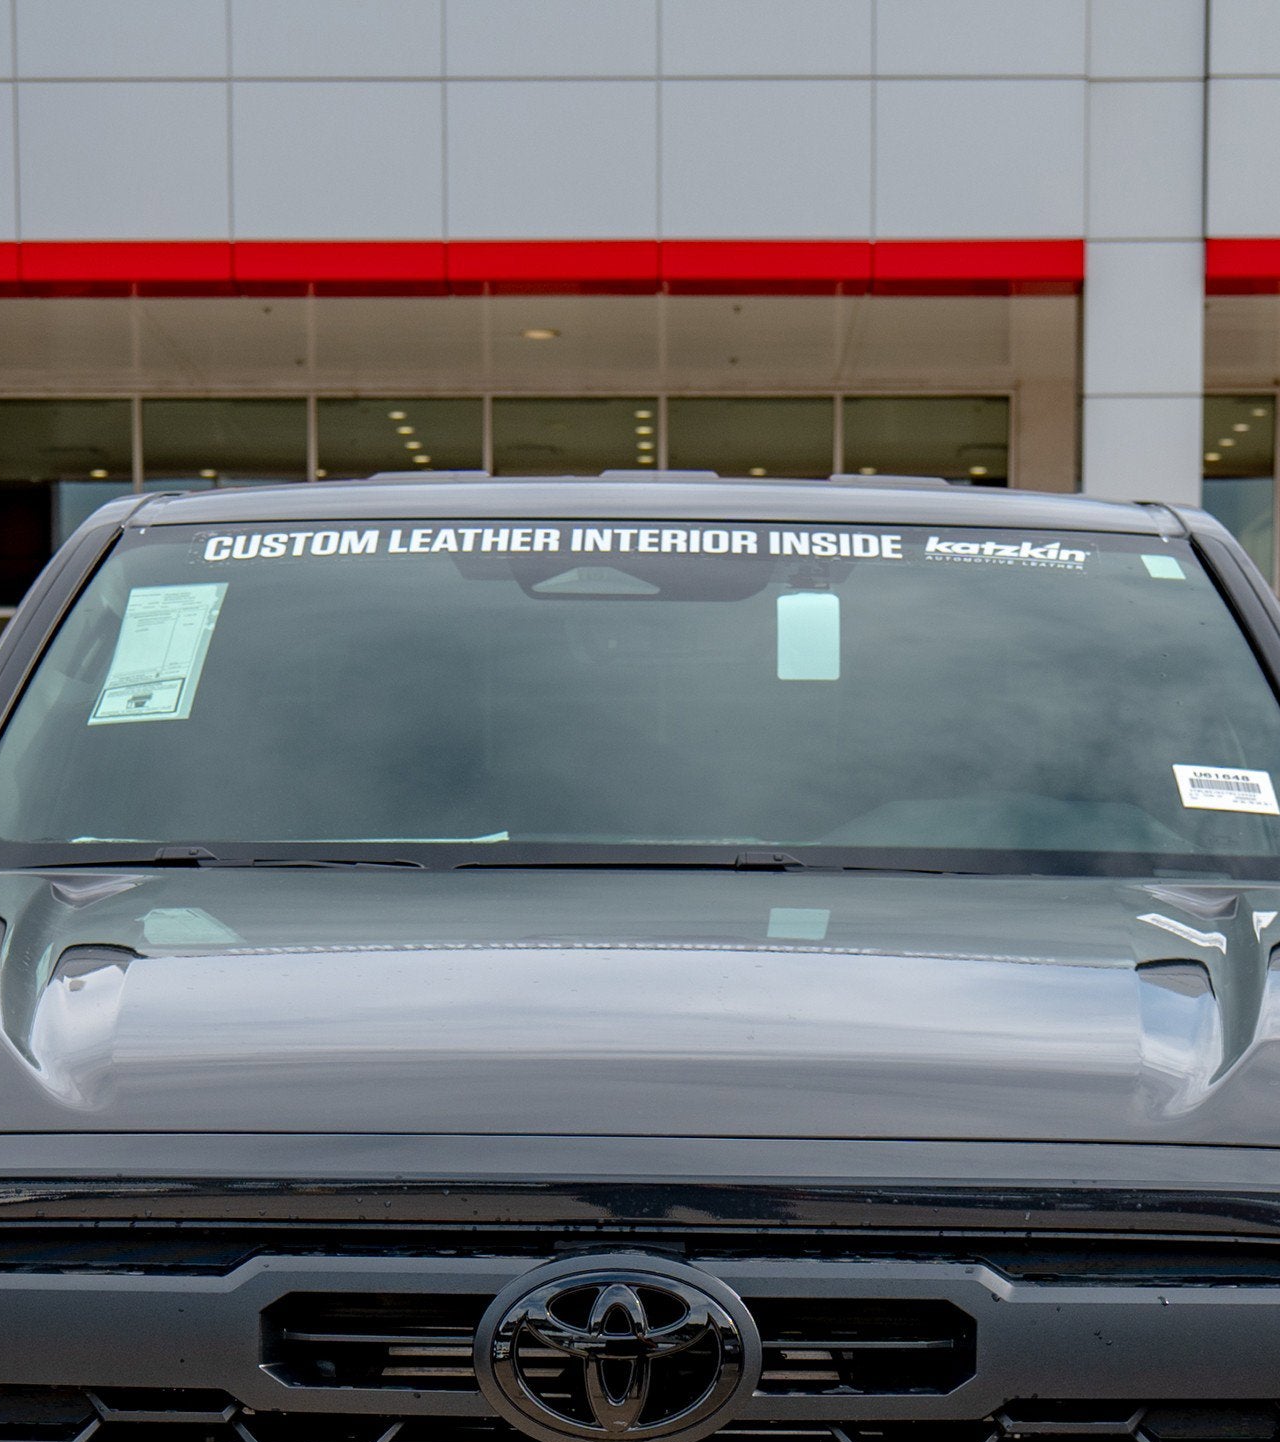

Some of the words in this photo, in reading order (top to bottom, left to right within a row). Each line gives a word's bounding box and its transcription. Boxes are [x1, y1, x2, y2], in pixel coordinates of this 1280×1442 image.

[204, 529, 380, 561] CUSTOM
[388, 528, 561, 553] LEATHER
[571, 528, 758, 554] INTERIOR
[769, 531, 903, 559] INSIDE
[925, 536, 1086, 562] katzkin
[925, 554, 1015, 565] AUTOMOTIVE
[1022, 560, 1085, 570] LEATHER
